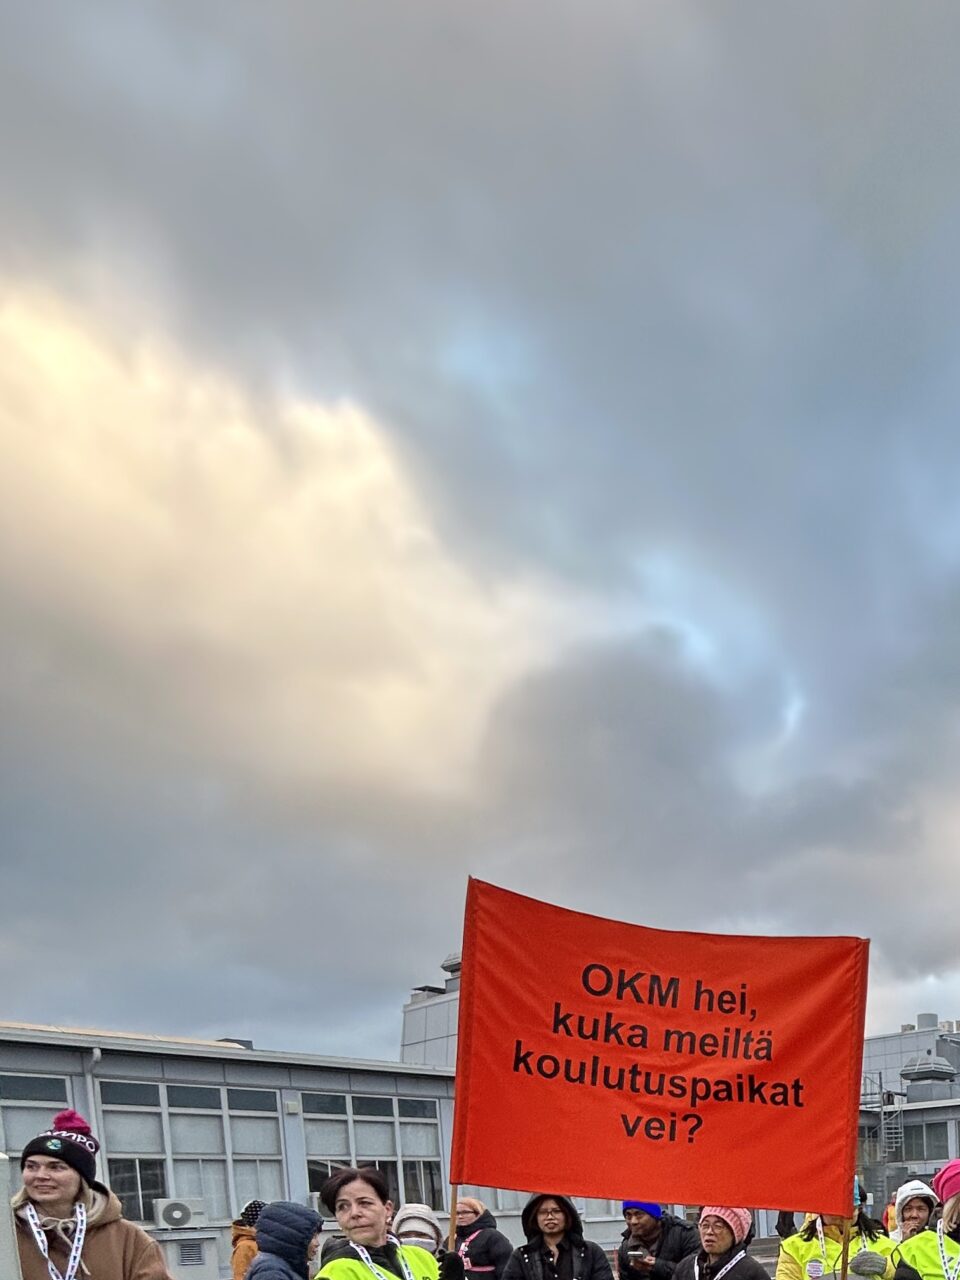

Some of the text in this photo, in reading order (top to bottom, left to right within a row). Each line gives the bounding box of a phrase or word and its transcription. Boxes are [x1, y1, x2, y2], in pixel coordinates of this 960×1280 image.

[581, 963, 757, 1021] OKM hei,
[552, 1002, 773, 1061] kuka meiltä
[513, 1039, 804, 1108] koulutuspaikat
[621, 1112, 703, 1143] vei?
